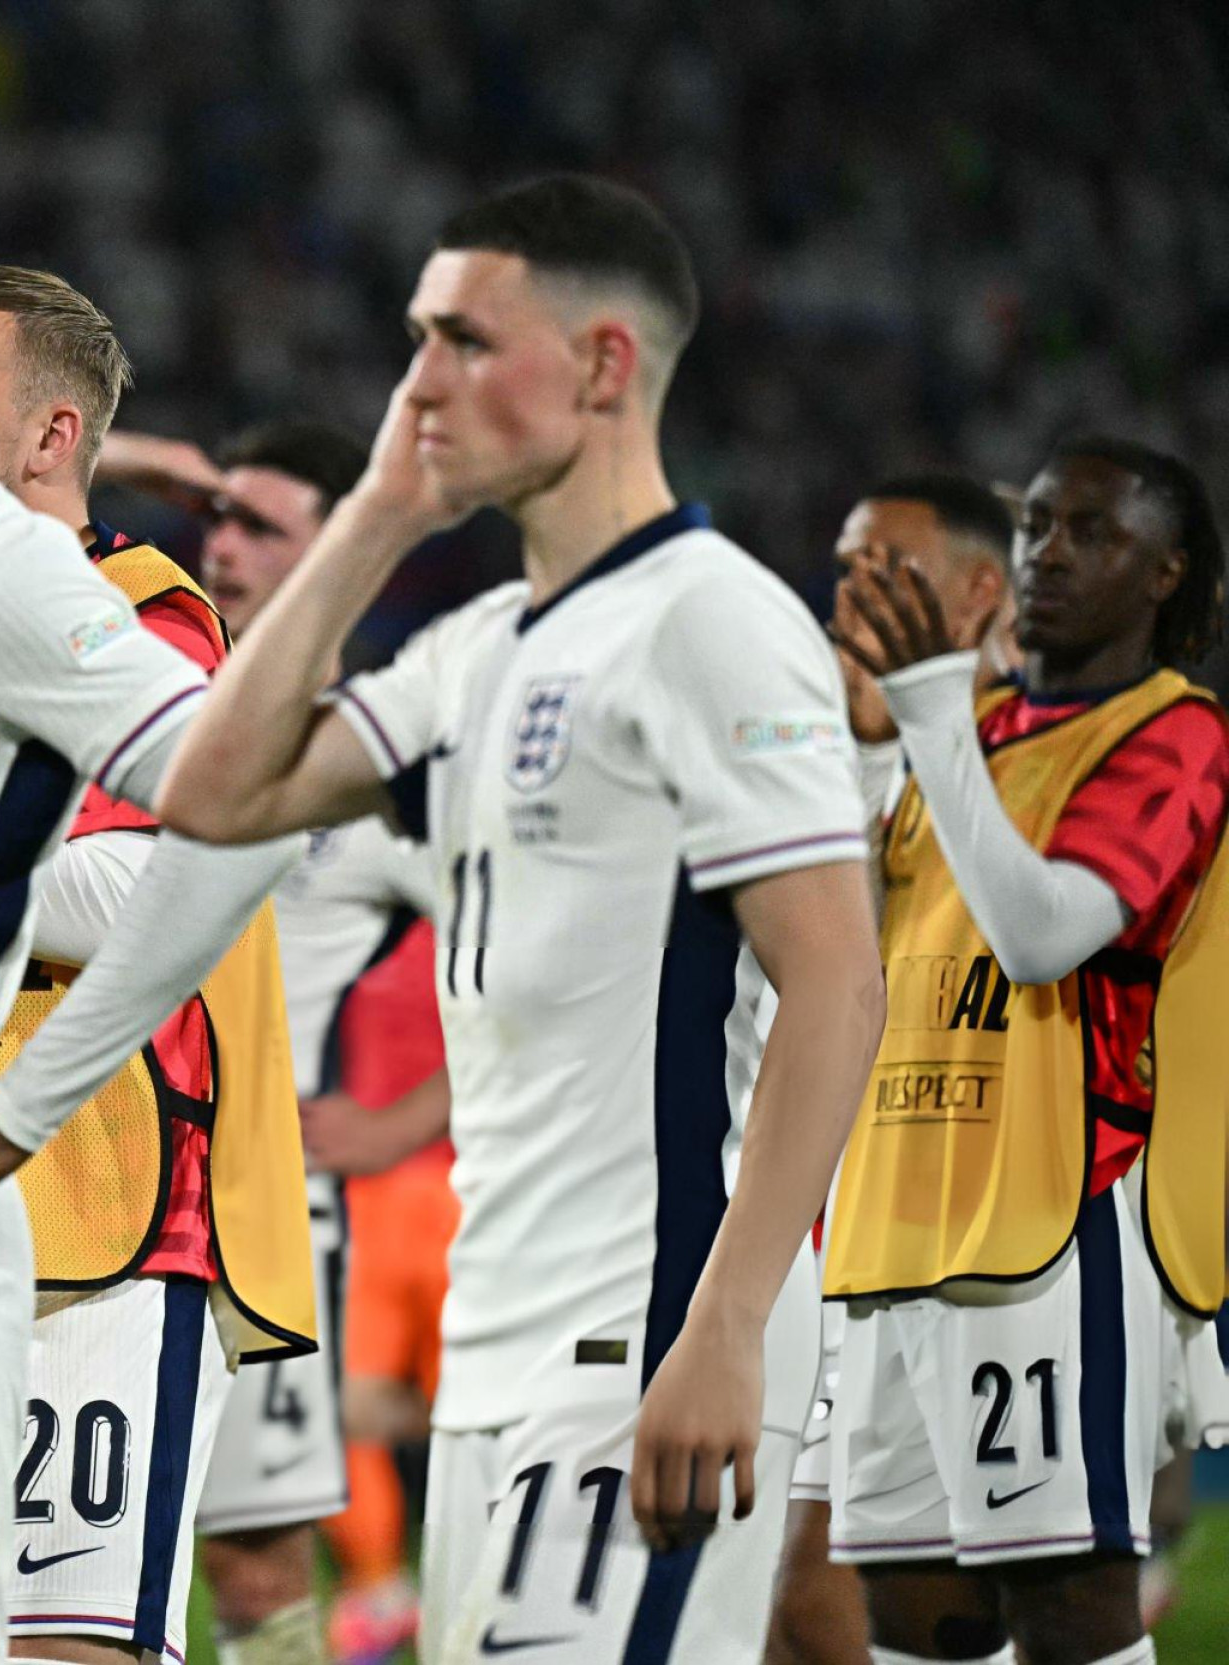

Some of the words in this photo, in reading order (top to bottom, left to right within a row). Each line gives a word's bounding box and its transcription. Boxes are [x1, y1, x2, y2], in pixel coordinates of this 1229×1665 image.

[447, 848, 491, 998] 11
[14, 1397, 131, 1528] 20
[971, 1357, 1062, 1464] 21
[499, 1461, 628, 1614] 11
